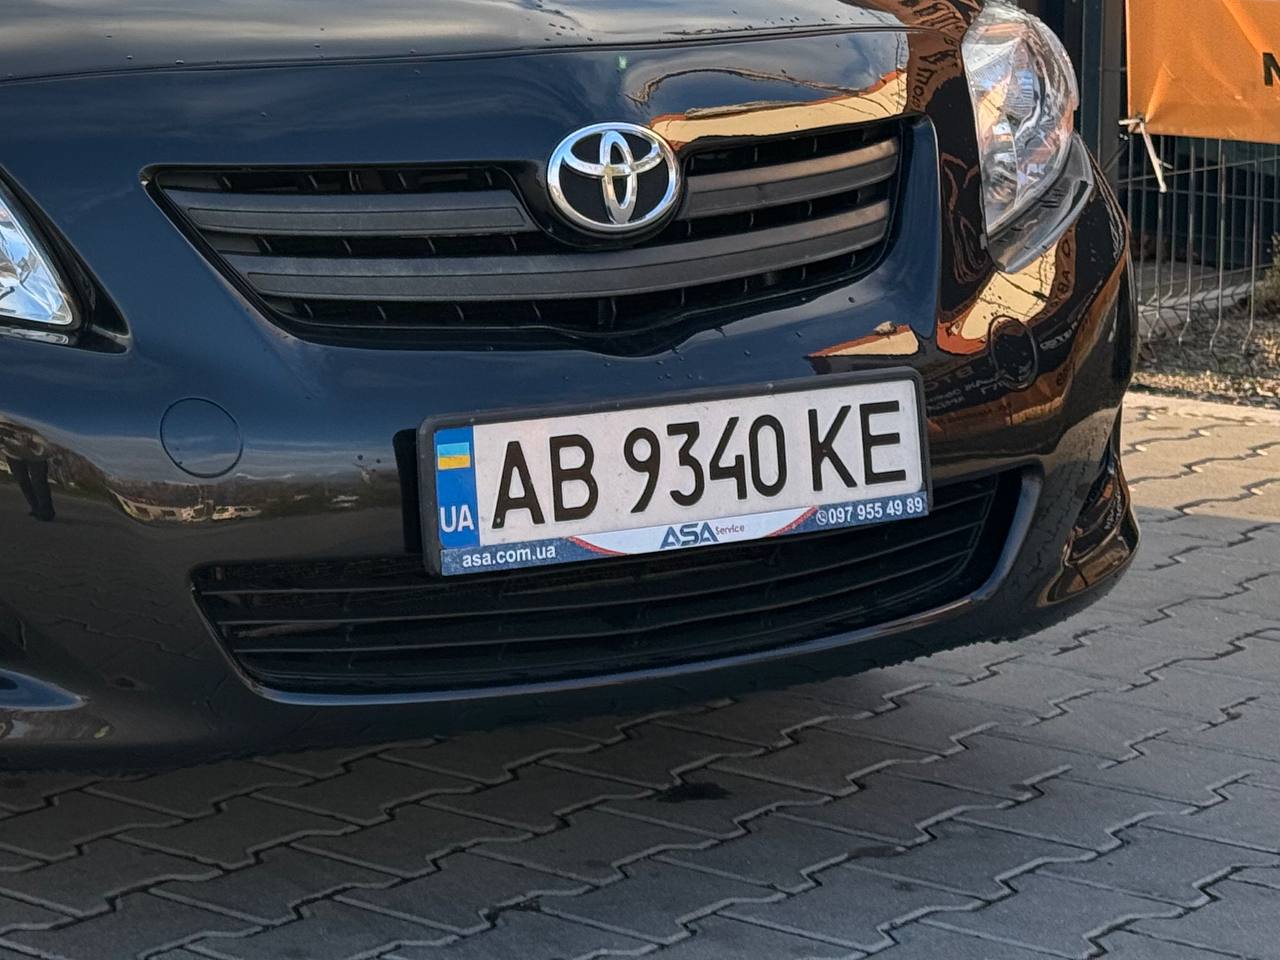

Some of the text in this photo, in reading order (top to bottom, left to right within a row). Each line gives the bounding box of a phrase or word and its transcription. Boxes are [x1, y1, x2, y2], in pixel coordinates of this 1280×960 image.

[491, 400, 907, 530] AB 9340 KE
[439, 504, 475, 533] UA
[828, 495, 924, 524] 097 955 49 89
[659, 522, 720, 550] ASA
[462, 545, 556, 568] asa.com.ua
